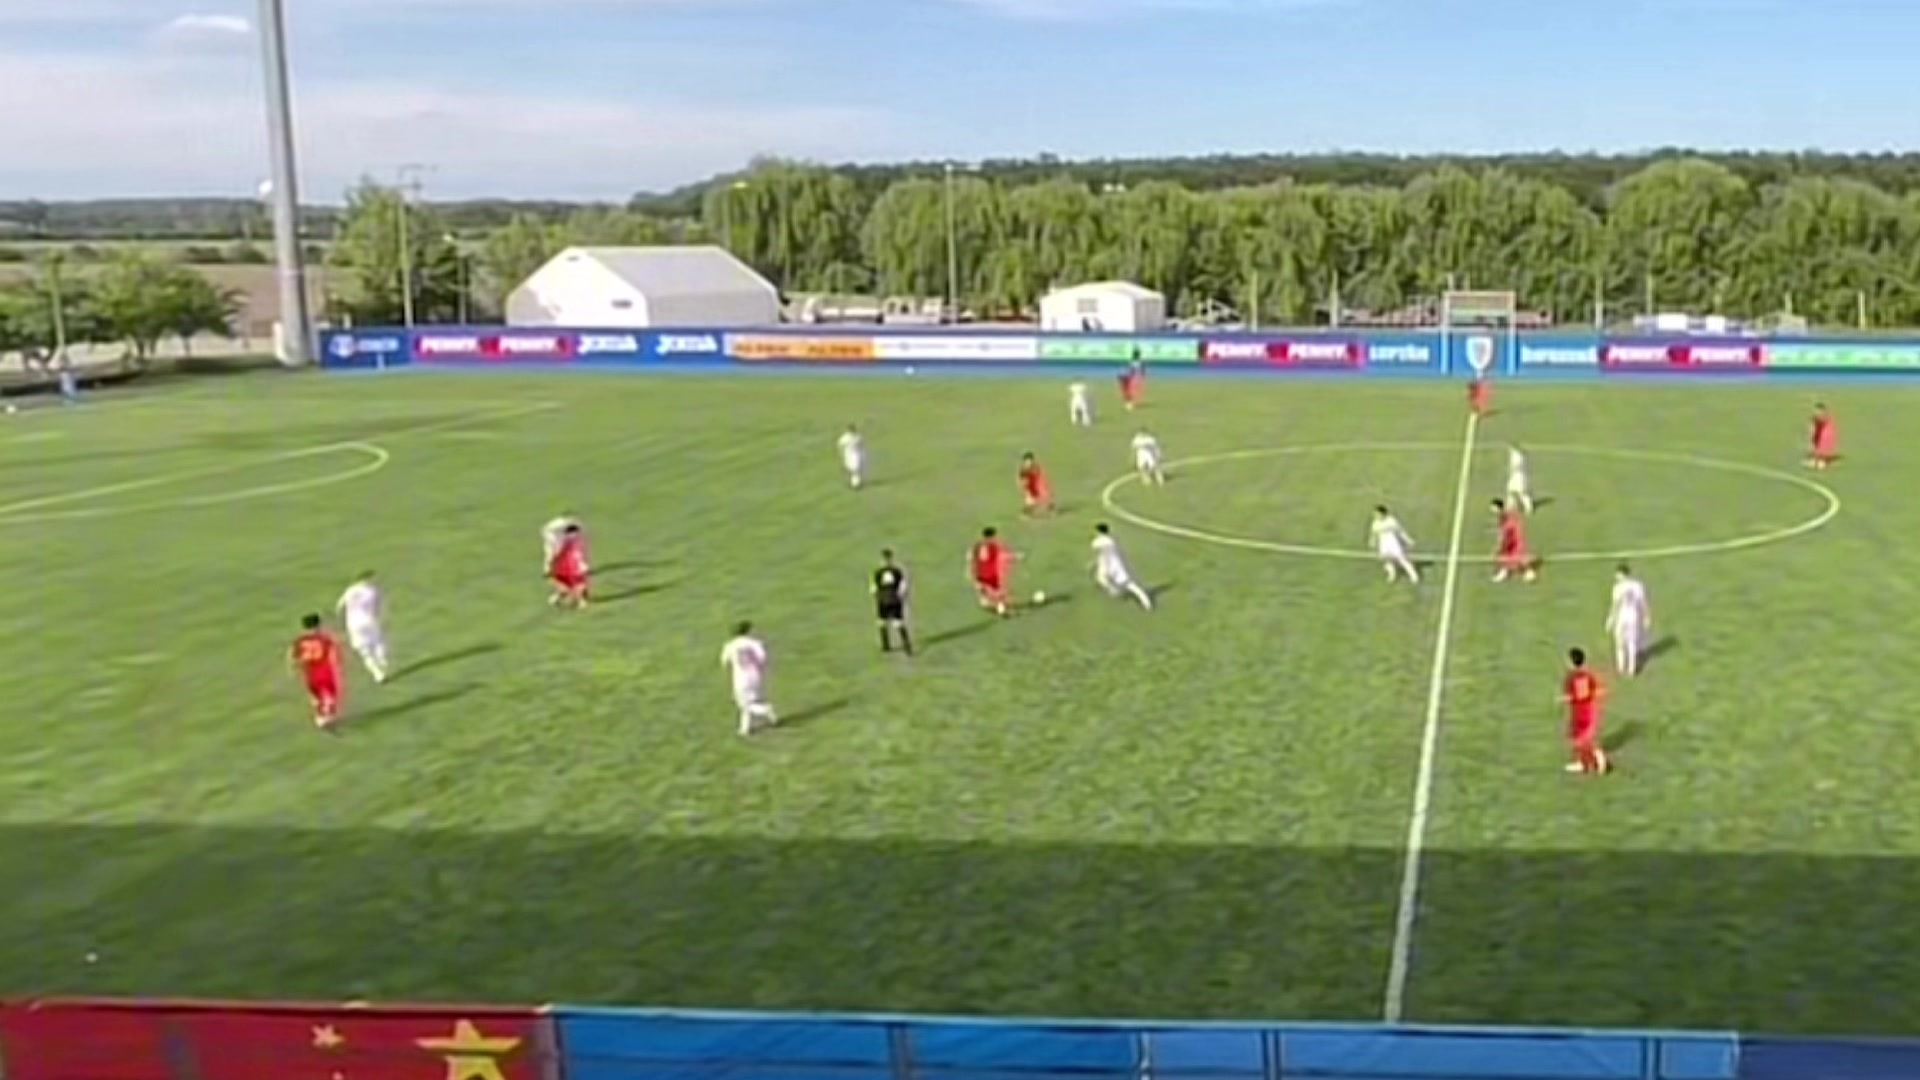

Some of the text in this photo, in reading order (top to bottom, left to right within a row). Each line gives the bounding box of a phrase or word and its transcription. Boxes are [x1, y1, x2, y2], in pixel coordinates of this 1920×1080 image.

[421, 337, 557, 352] PENNY PENNY
[1207, 343, 1266, 359] PENNY
[1288, 343, 1347, 360] PENNY
